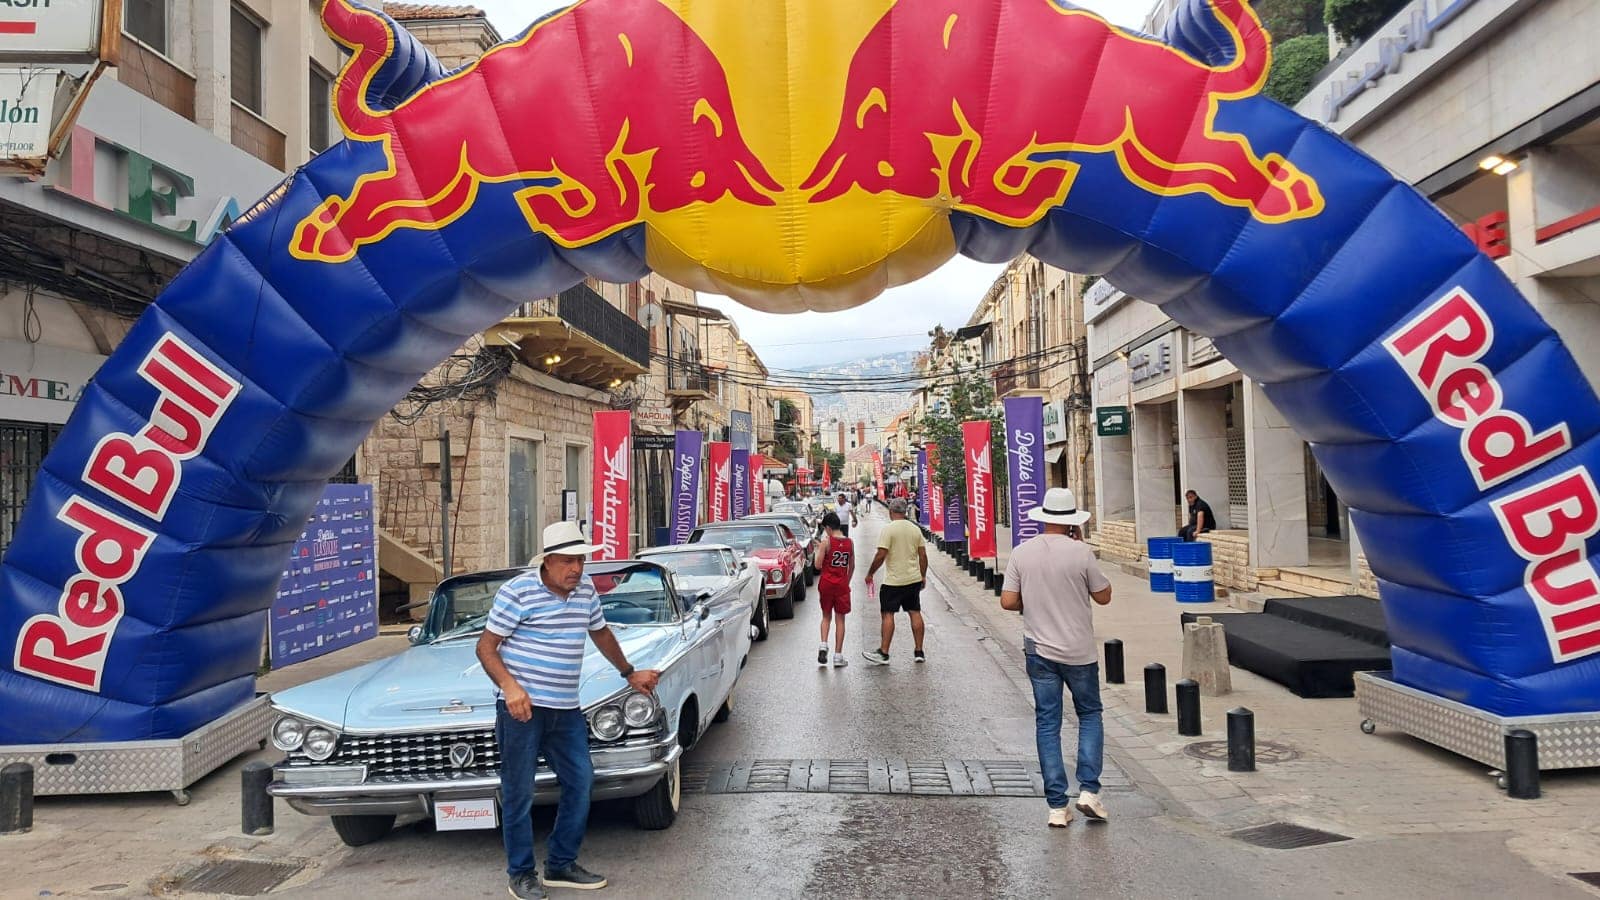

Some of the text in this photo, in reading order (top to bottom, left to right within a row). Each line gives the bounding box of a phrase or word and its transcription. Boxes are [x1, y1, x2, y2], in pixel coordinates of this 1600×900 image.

[17, 337, 236, 690] Red Bull
[595, 436, 628, 560] Autopia
[710, 457, 730, 522] Autopi
[733, 488, 745, 520] CLASSIQU
[968, 441, 992, 540] Autopia
[1391, 293, 1600, 657] Red Bull
[832, 551, 849, 567] 23
[437, 805, 494, 821] Autopia
